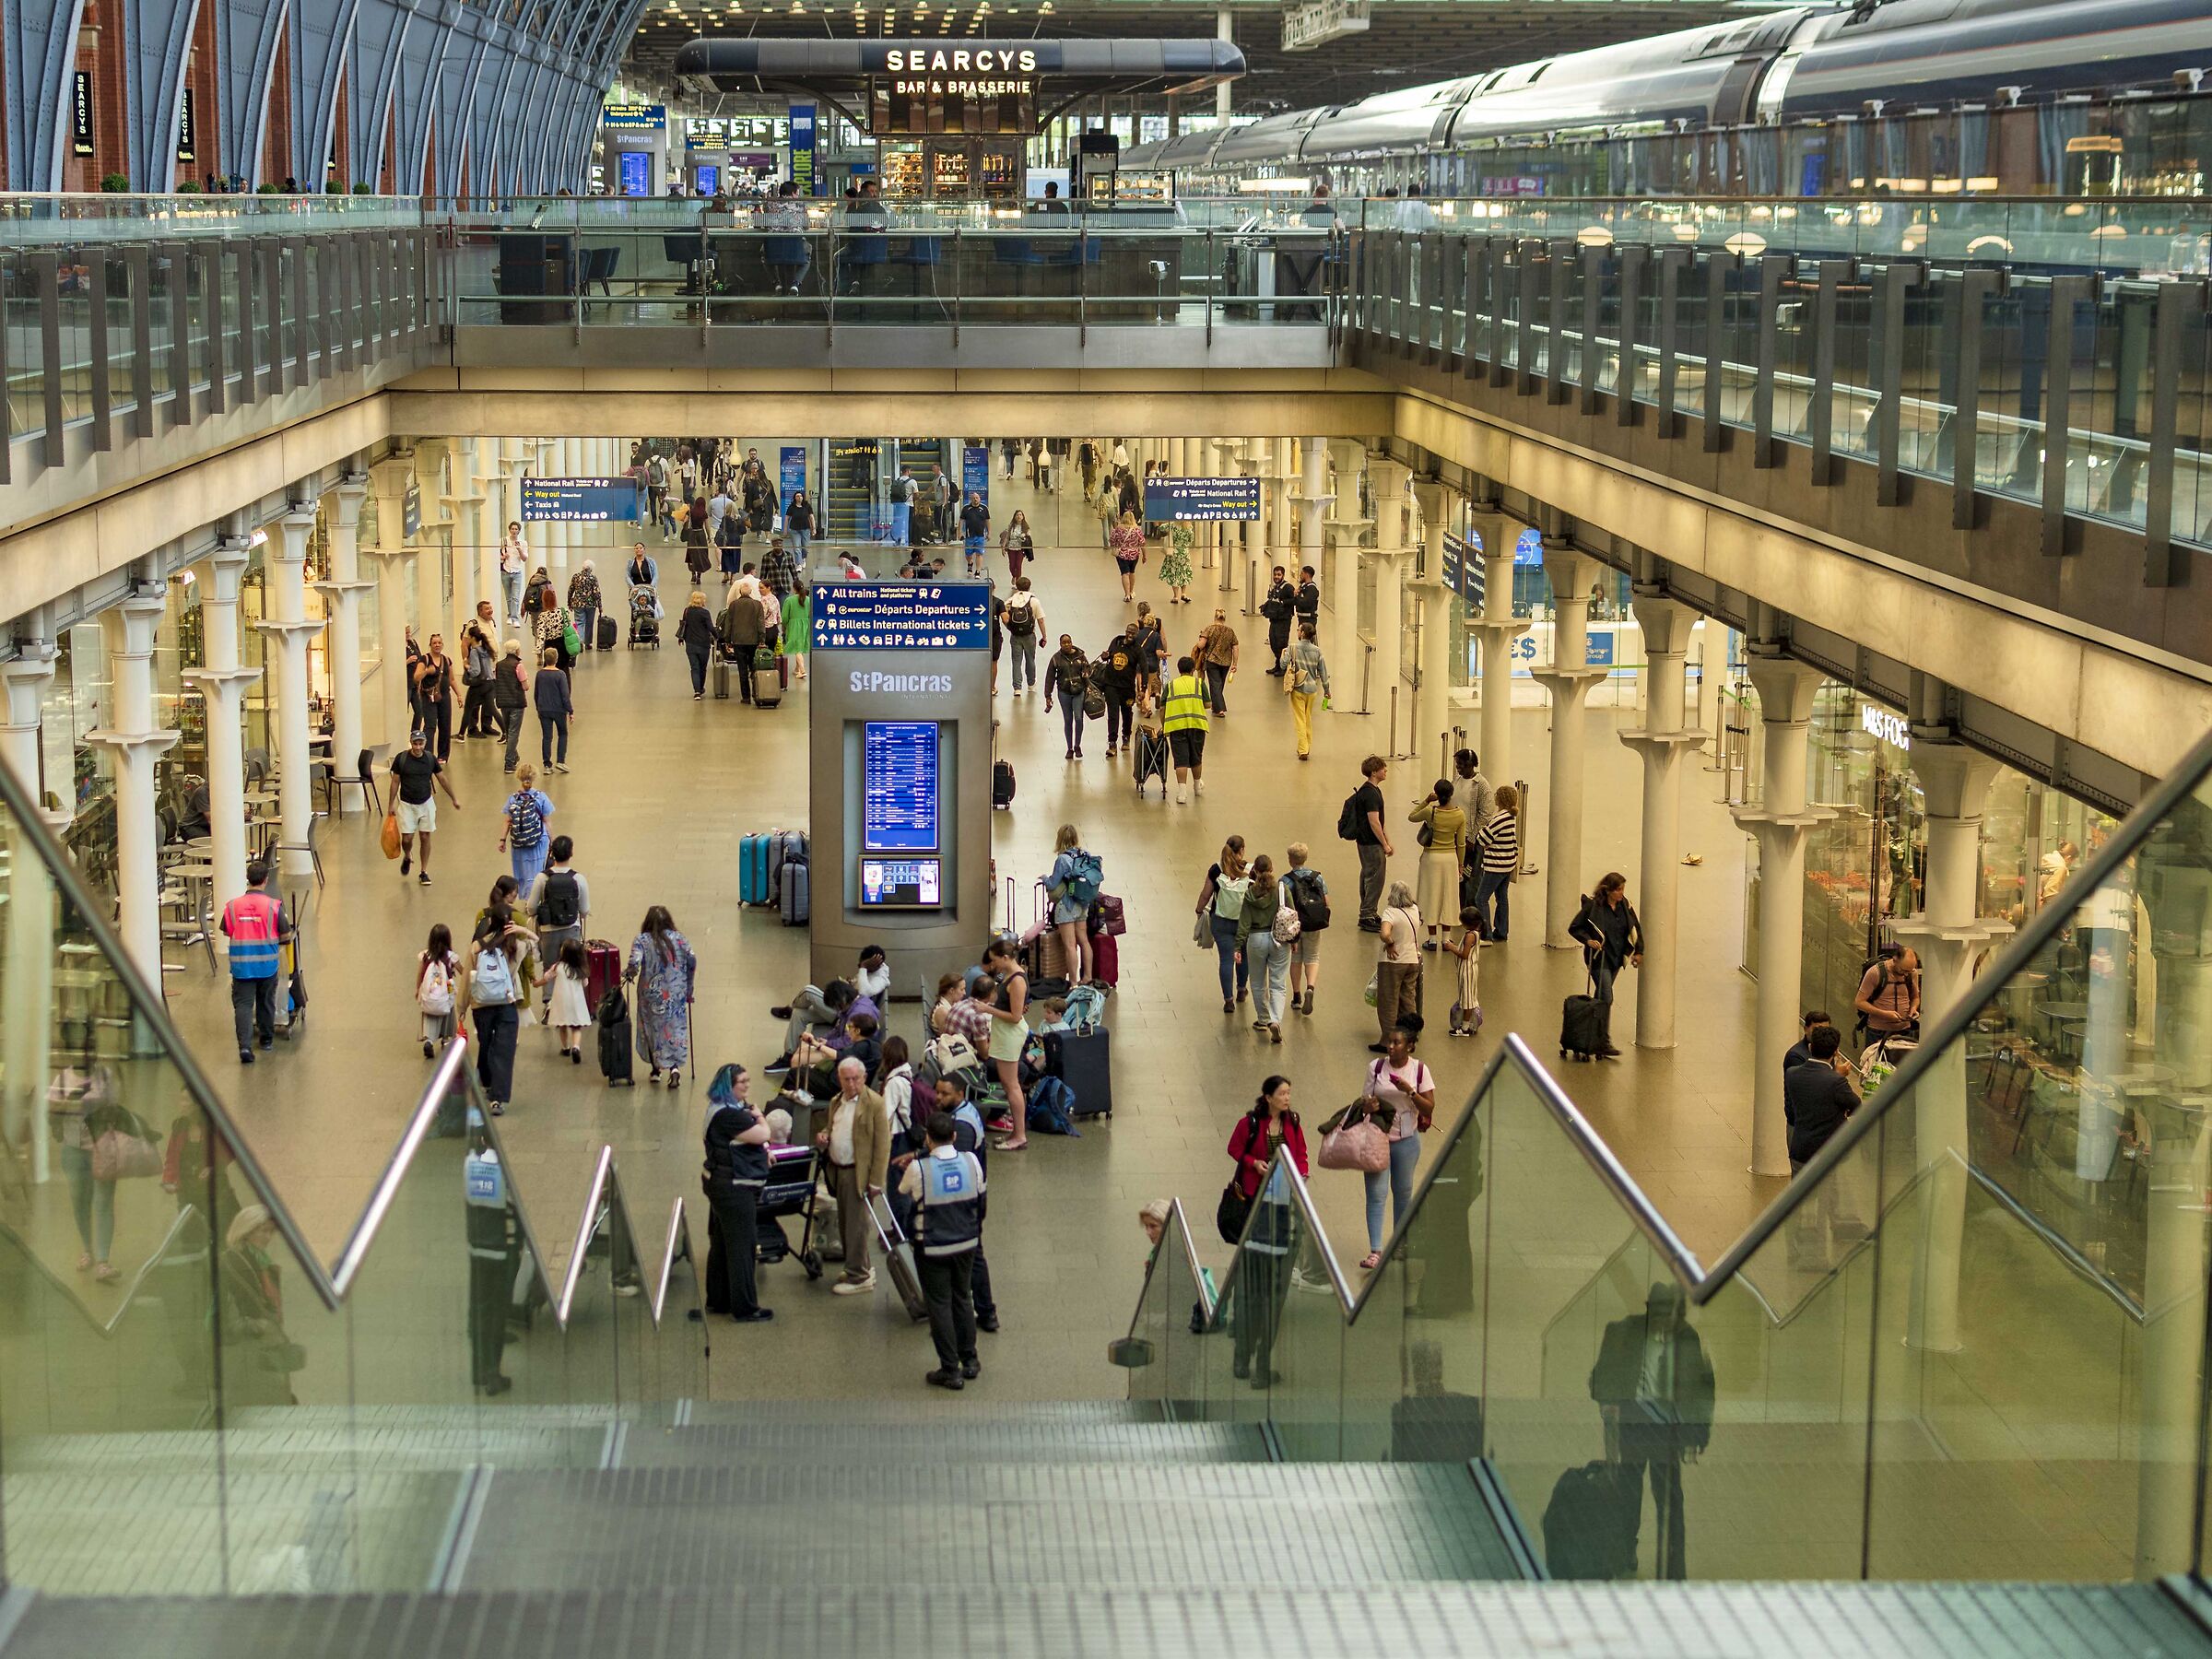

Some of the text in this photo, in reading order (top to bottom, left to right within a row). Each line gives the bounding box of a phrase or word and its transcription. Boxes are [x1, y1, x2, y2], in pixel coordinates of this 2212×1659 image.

[887, 50, 1036, 71] SEARCYS
[897, 81, 1030, 93] BAR & BRASSERIE
[77, 75, 87, 134] SEARCYS
[1185, 478, 1211, 487] Départs
[832, 588, 877, 598] All trains
[875, 604, 970, 616] Départs Departures
[839, 619, 970, 629] Billets International tickets
